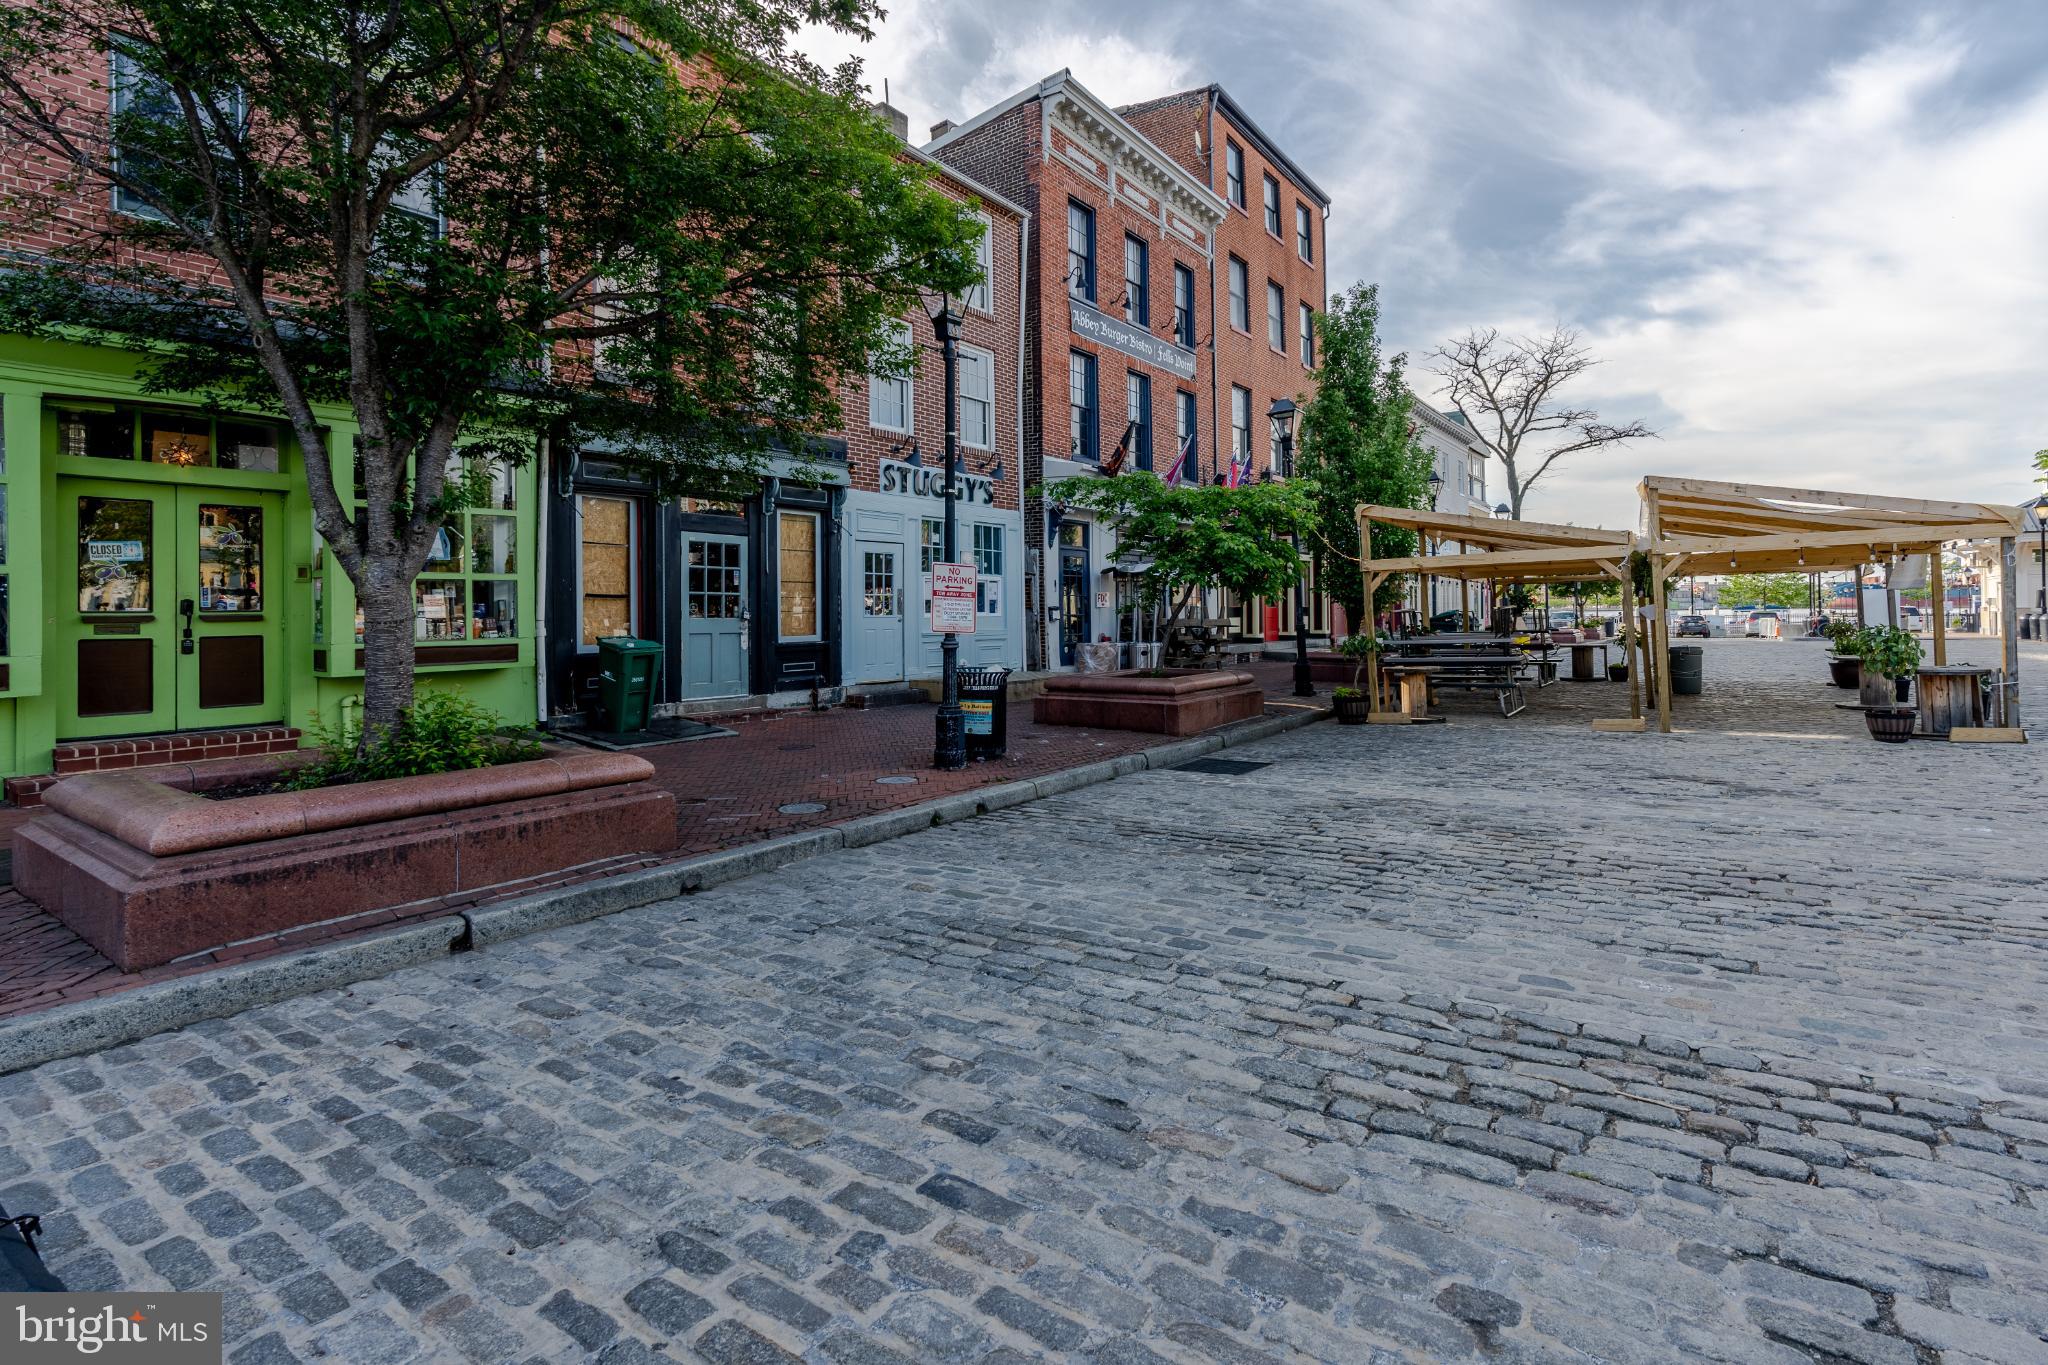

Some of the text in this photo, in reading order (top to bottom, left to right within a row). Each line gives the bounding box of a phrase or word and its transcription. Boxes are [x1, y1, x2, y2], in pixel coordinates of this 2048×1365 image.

[1073, 310, 1099, 335] Abbey
[1100, 321, 1128, 344] Burger
[1129, 334, 1153, 355] Bistro
[1174, 354, 1193, 373] Point
[883, 464, 994, 505] STUGGY'S
[90, 545, 122, 555] CLOSED
[948, 567, 961, 576] NO
[935, 575, 973, 585] PARKING
